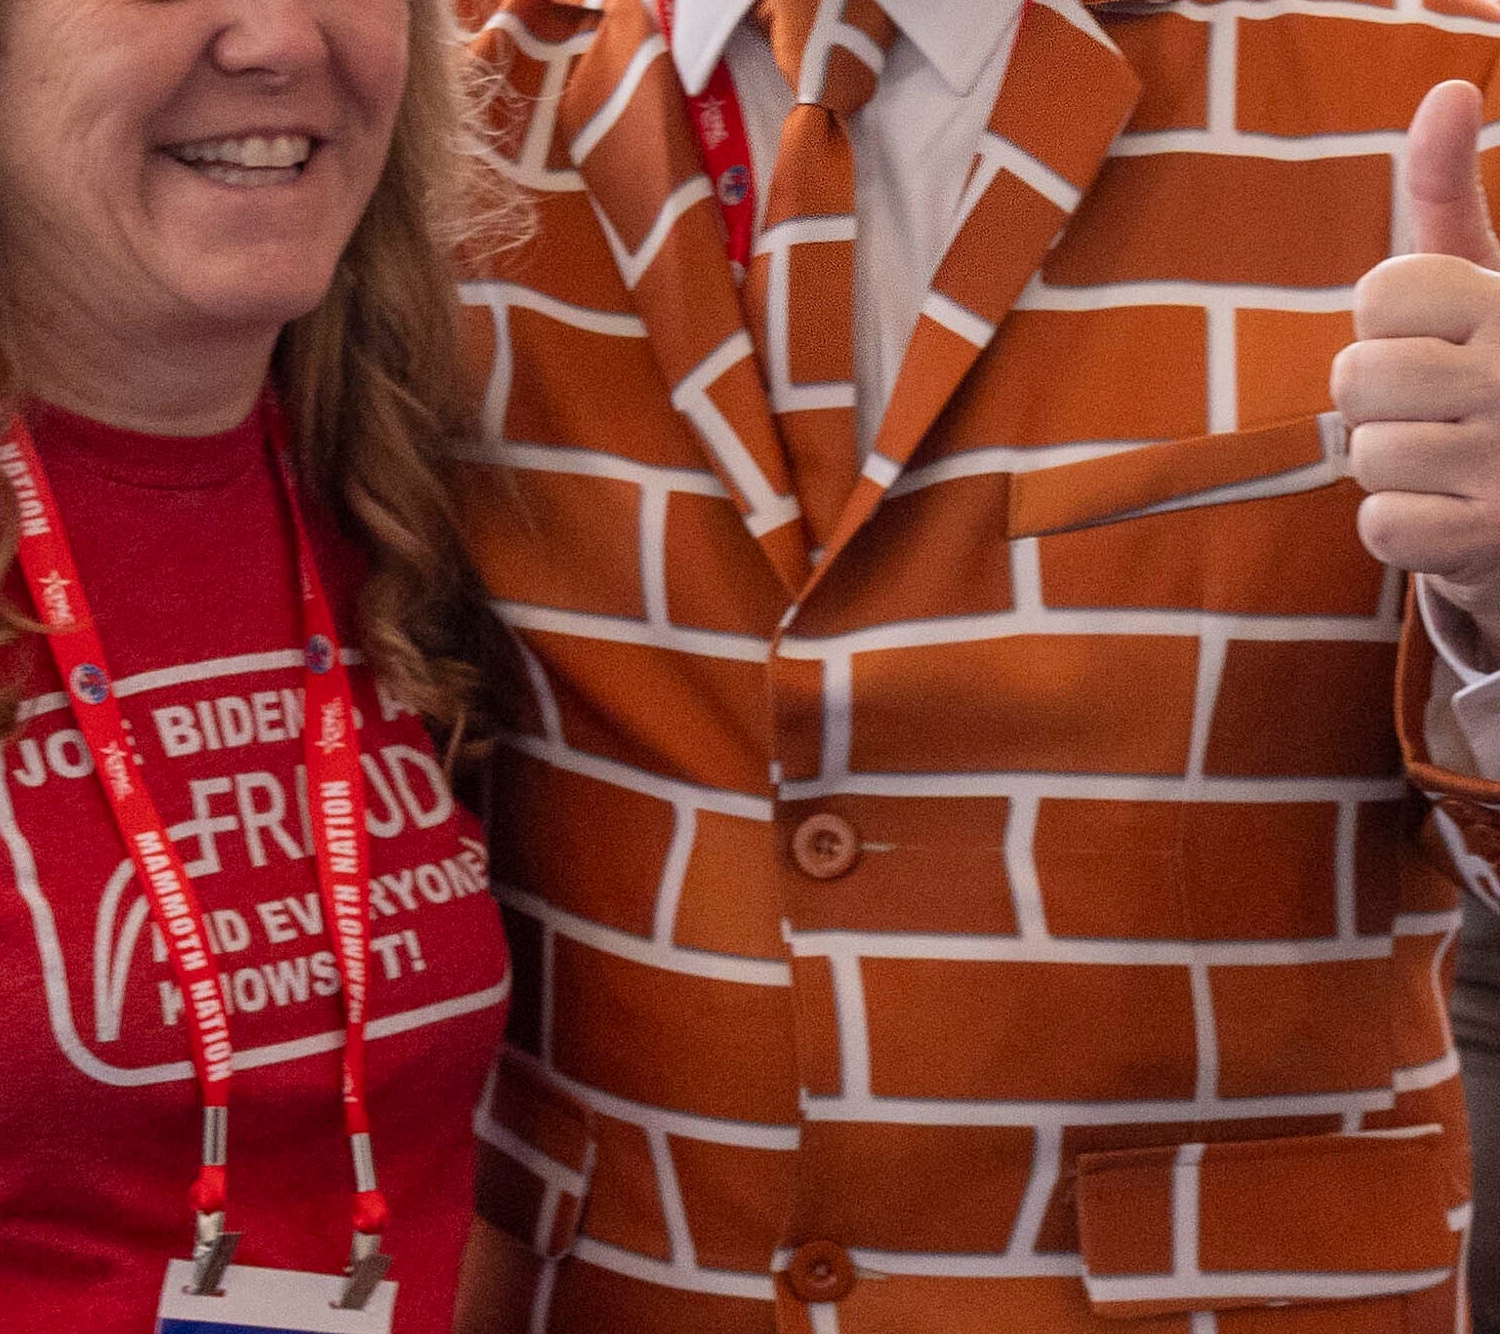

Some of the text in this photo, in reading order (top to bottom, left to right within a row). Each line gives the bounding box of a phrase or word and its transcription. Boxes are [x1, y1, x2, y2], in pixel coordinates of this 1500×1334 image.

[319, 779, 359, 874] NATION
[134, 830, 209, 972] MAMMOTH
[188, 978, 233, 1083] NATION
